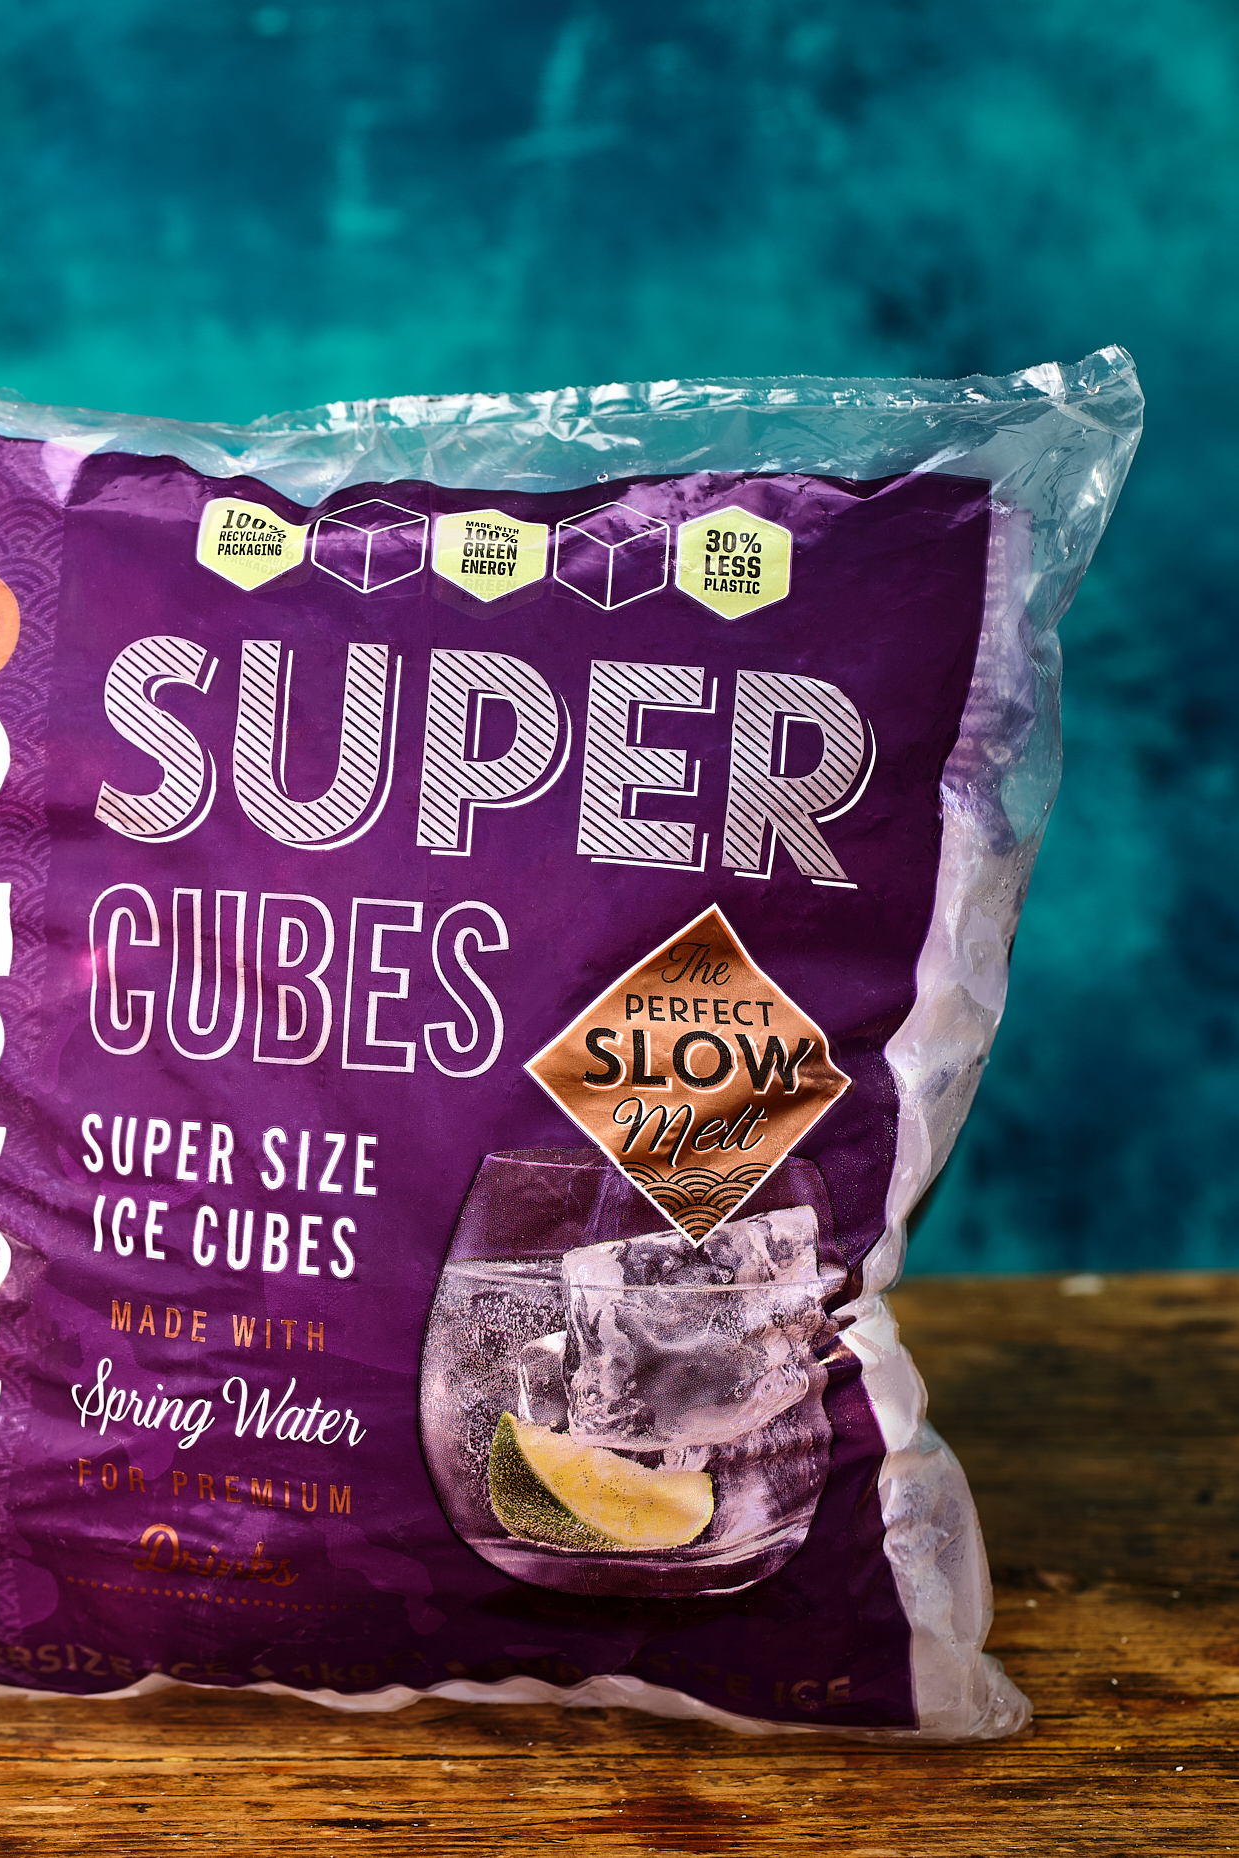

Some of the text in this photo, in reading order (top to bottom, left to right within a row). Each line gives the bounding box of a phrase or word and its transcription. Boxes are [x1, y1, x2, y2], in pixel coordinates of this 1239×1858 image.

[219, 530, 285, 544] RECYCLABLE
[222, 509, 287, 539] 100%
[464, 527, 518, 544] 100%
[466, 520, 520, 534] MADE WITH
[705, 529, 762, 554] 30%
[217, 543, 282, 556] PACKAGING
[461, 559, 516, 576] ENERGY
[463, 542, 518, 560] GREEN
[704, 554, 761, 579] LESS
[704, 578, 761, 595] PLASTIC
[93, 634, 876, 889] SUPER
[88, 882, 510, 1079] CUBES
[661, 942, 731, 986] The
[624, 993, 774, 1027] PERFECT
[582, 1027, 816, 1095] SLOW
[612, 1096, 768, 1168] Melt
[81, 1113, 379, 1196] SUPER SIZE
[93, 1195, 357, 1279] ICE CUBES
[111, 1300, 325, 1352] MADE WITH
[71, 1357, 367, 1450] Spring Water
[77, 1458, 353, 1515] FOR PREMIUM
[133, 1522, 300, 1588] Drinks
[153, 1661, 235, 1680] CE
[772, 1675, 852, 1706] ICE
